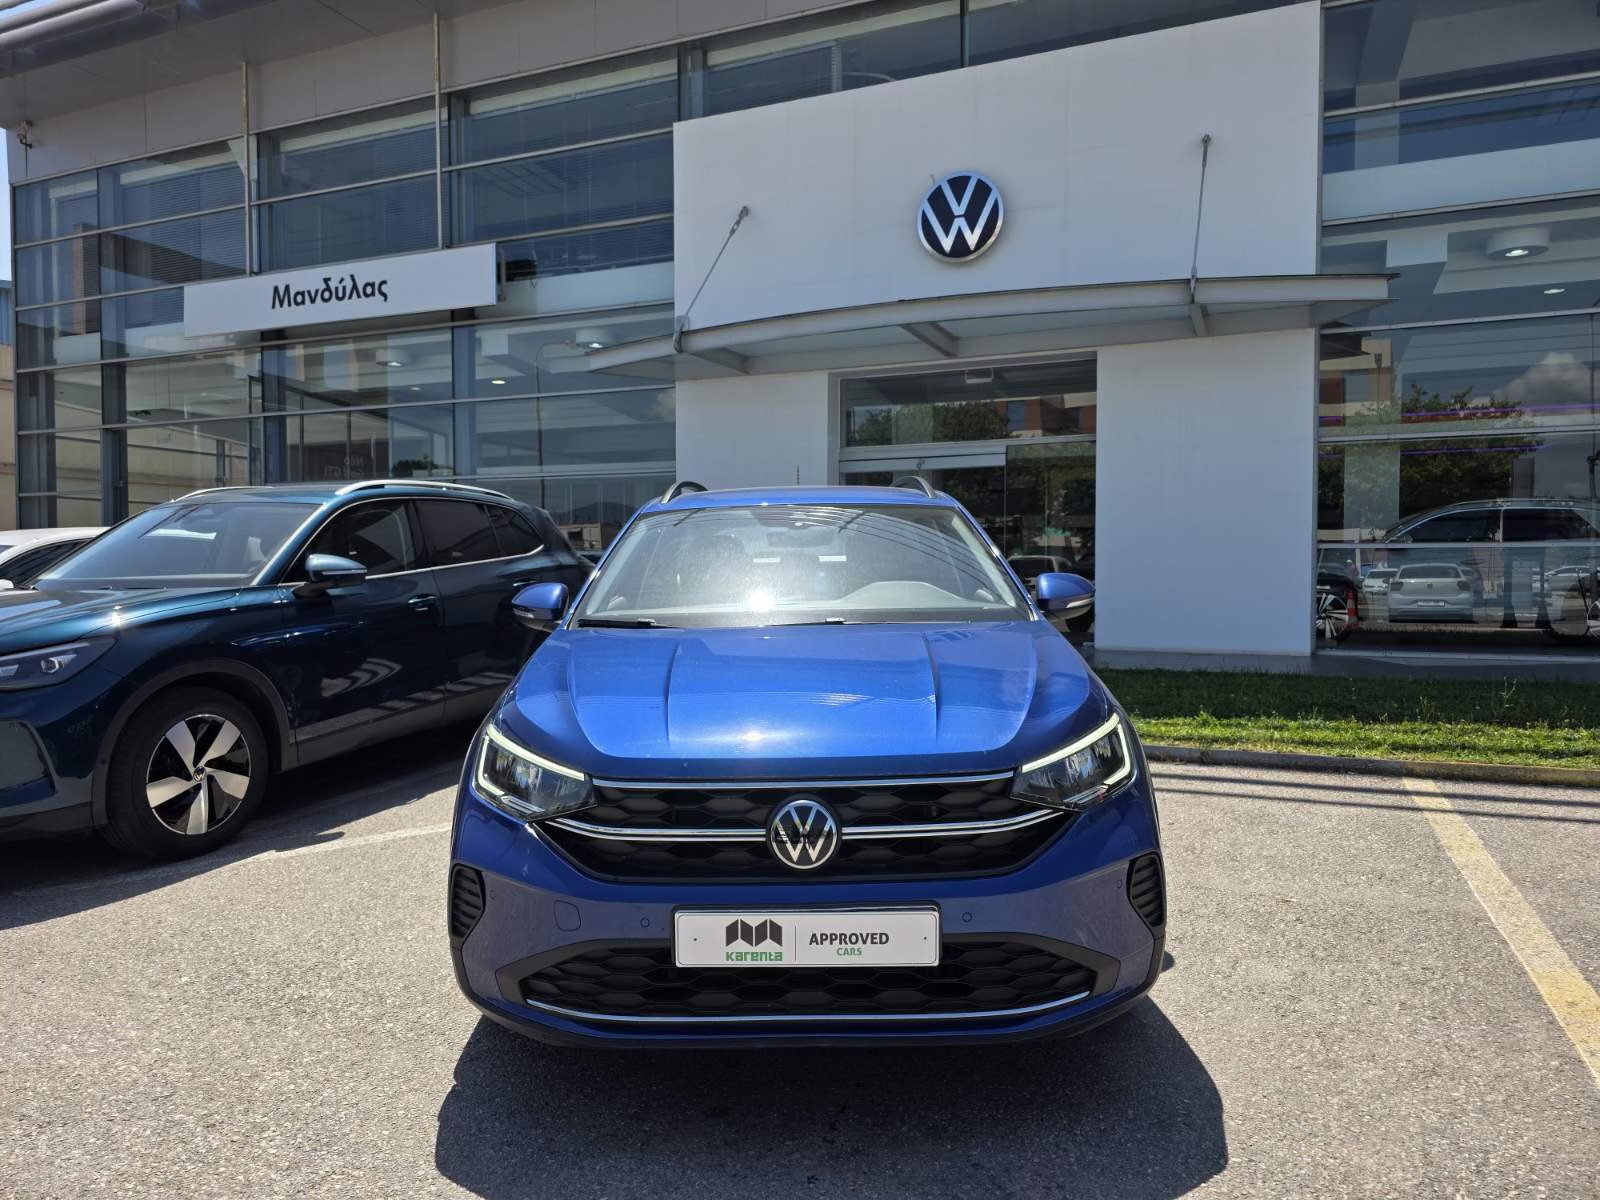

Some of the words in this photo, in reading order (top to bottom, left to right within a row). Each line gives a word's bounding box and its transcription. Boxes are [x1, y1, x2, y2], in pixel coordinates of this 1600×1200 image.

[919, 174, 1001, 257] VW
[271, 274, 388, 309] Μανδύλας
[774, 802, 835, 865] VW
[809, 932, 890, 945] APPROVED
[836, 947, 863, 956] CARS
